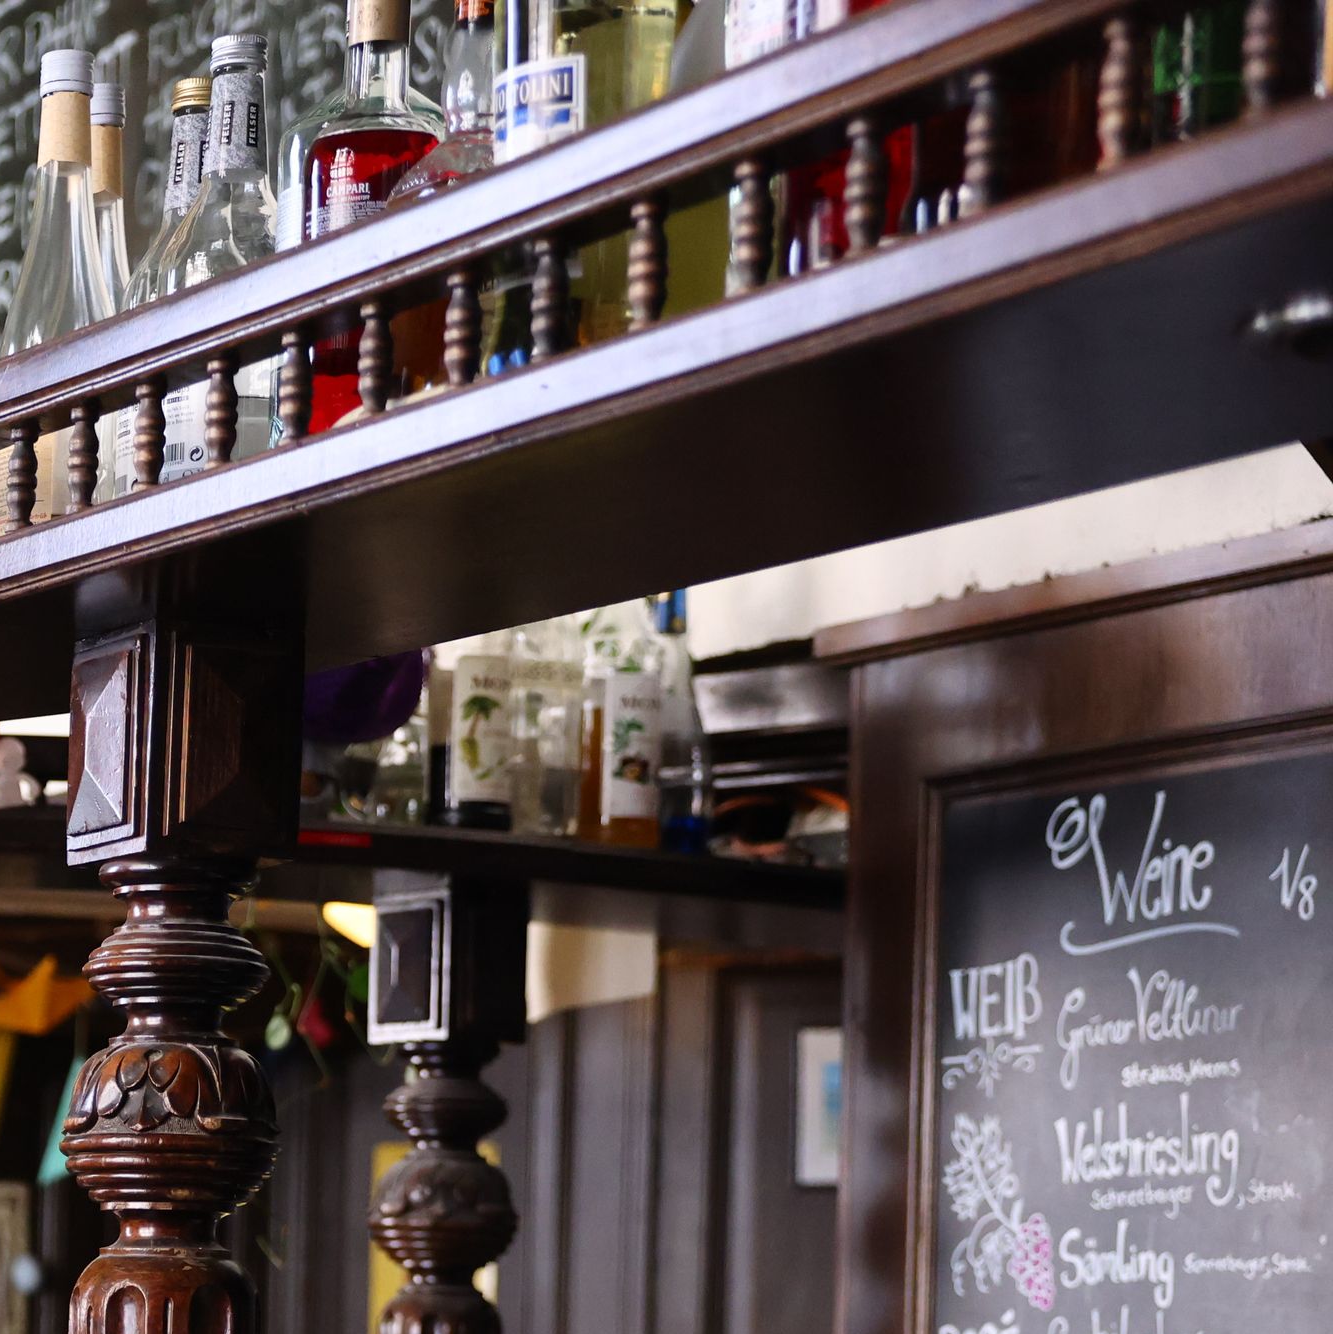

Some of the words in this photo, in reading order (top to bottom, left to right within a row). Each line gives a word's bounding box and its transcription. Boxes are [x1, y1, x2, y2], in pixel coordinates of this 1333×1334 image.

[221, 103, 232, 143] FELSER
[247, 105, 257, 145] FELSER
[175, 143, 186, 182] FELSER
[1046, 790, 1215, 926] Weine
[1059, 1218, 1174, 1308] Sämling
